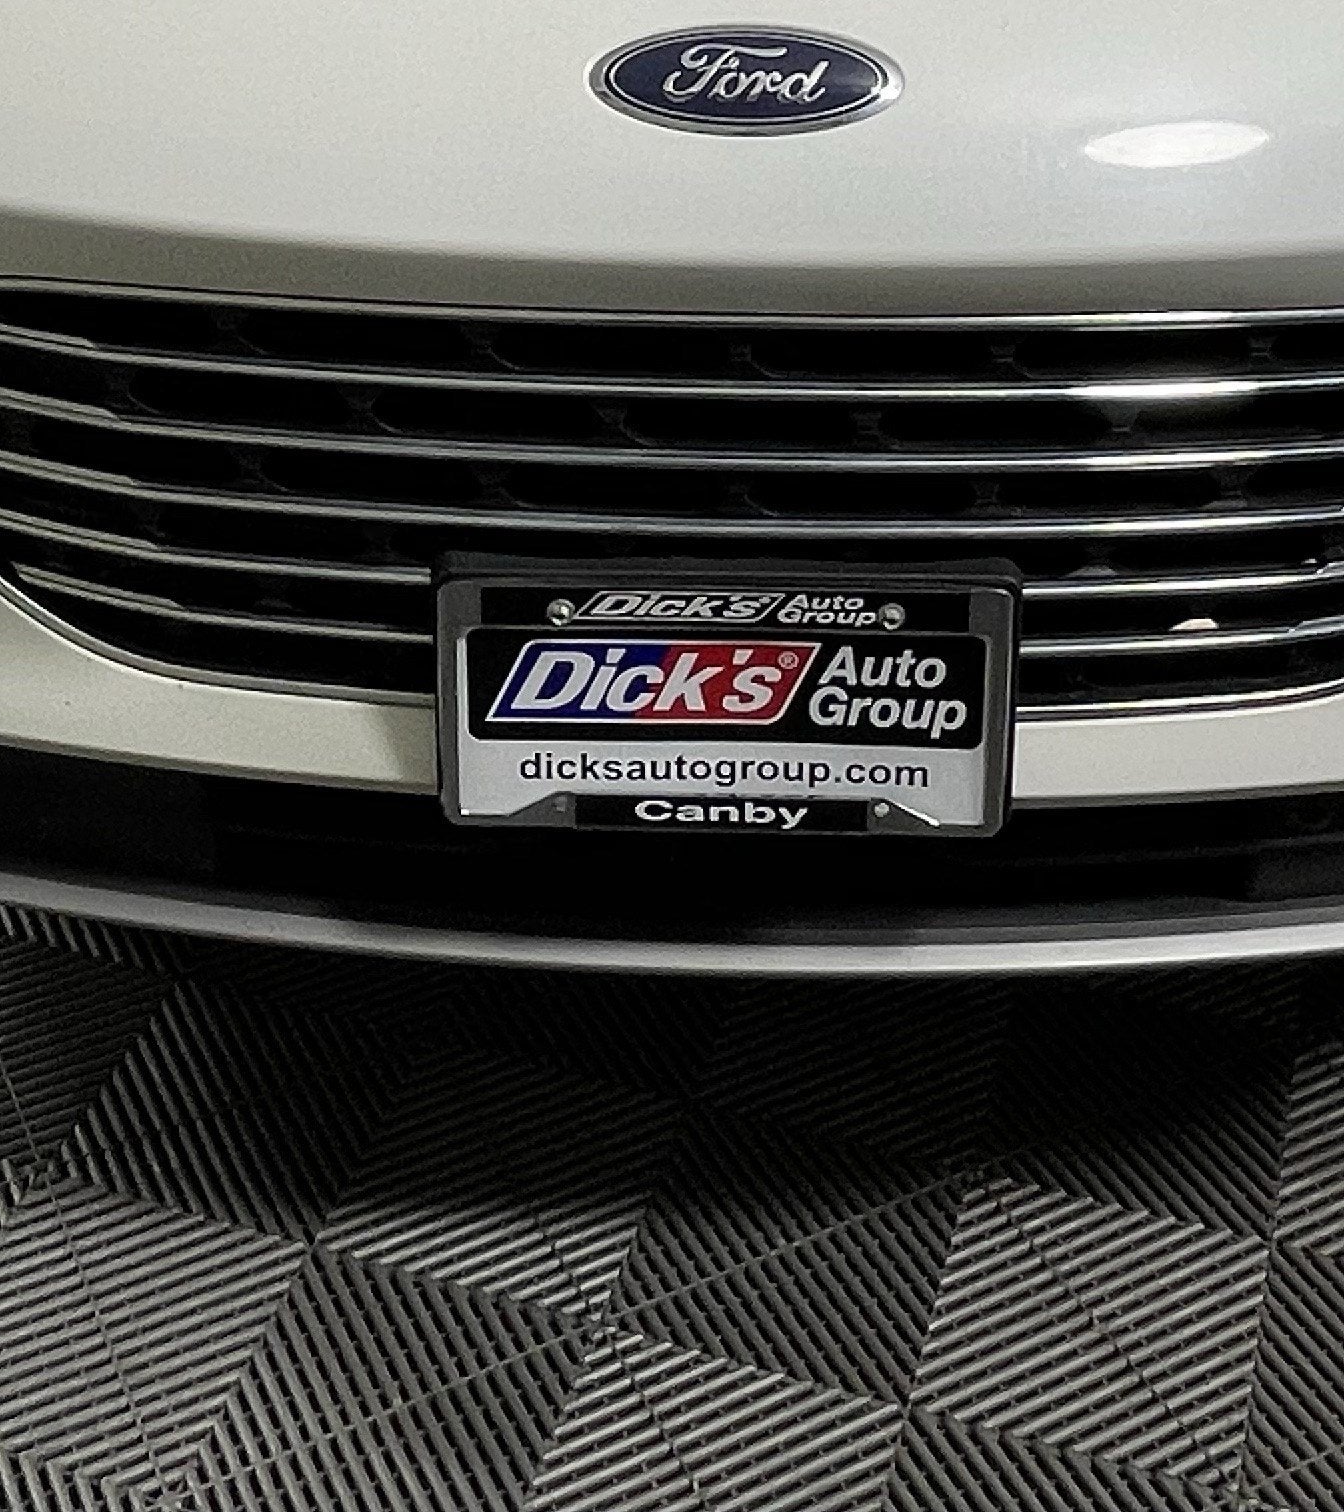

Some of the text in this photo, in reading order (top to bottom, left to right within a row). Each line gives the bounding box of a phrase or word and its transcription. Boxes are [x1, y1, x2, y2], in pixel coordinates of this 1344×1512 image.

[662, 42, 830, 103] Ford
[777, 609, 877, 628] Group
[788, 594, 864, 610] Auto
[818, 645, 947, 688] Auto
[808, 686, 968, 740] Group
[518, 752, 929, 788] dicksautogroup.com
[633, 799, 809, 830] Canby
